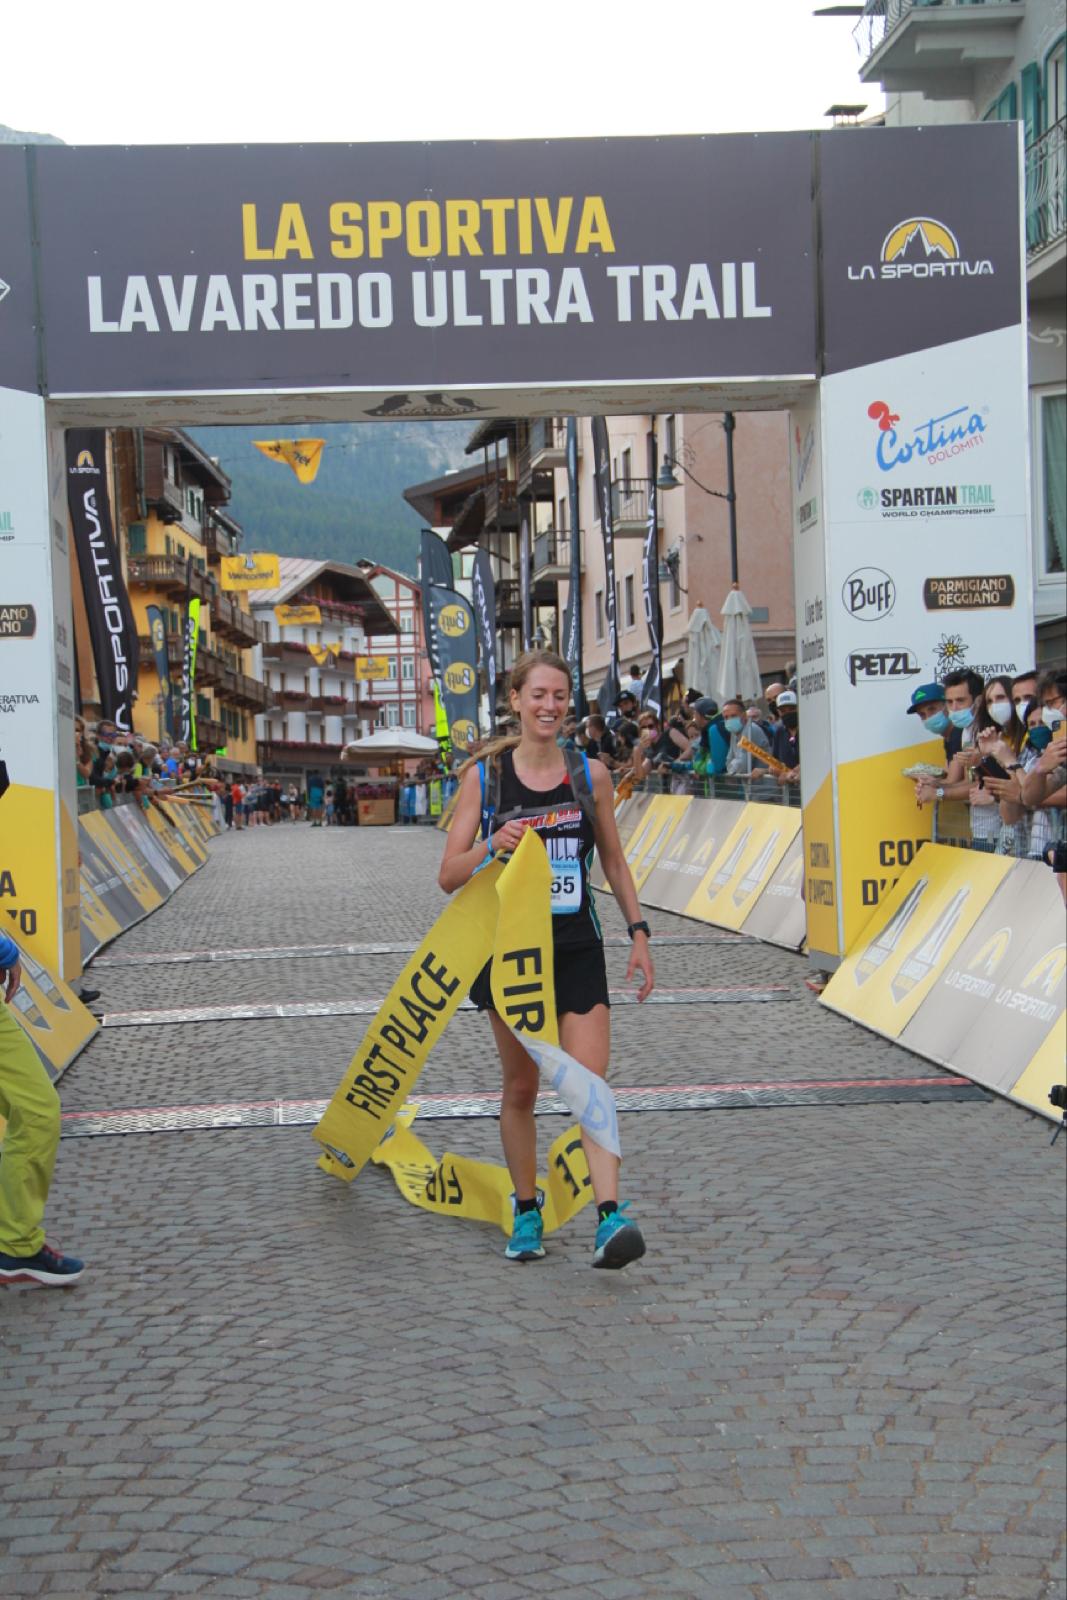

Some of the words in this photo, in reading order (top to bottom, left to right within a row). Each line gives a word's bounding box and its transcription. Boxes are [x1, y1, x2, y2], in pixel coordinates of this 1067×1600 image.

[242, 203, 314, 260] LA
[329, 196, 616, 259] SPORTIVA
[848, 266, 875, 280] LA
[881, 260, 994, 279] SPORTIVA
[87, 272, 394, 333] LAVAREDO
[411, 267, 594, 328] ULTRA
[606, 262, 772, 322] TRAIL
[876, 406, 987, 471] Cortina
[928, 435, 984, 465] DOLOMITI
[881, 486, 957, 507] SPARTAN
[961, 485, 995, 503] TRAIL
[882, 510, 918, 518] WORLD
[920, 508, 995, 517] CHAMPIONSHIP
[83, 487, 130, 692] SPORTIVA
[930, 578, 1007, 593] PARMIGIANO
[938, 591, 1000, 606] REGGIANO
[850, 653, 921, 687] PETZL
[345, 1043, 407, 1120] FIRST
[381, 951, 461, 1058] PLACE
